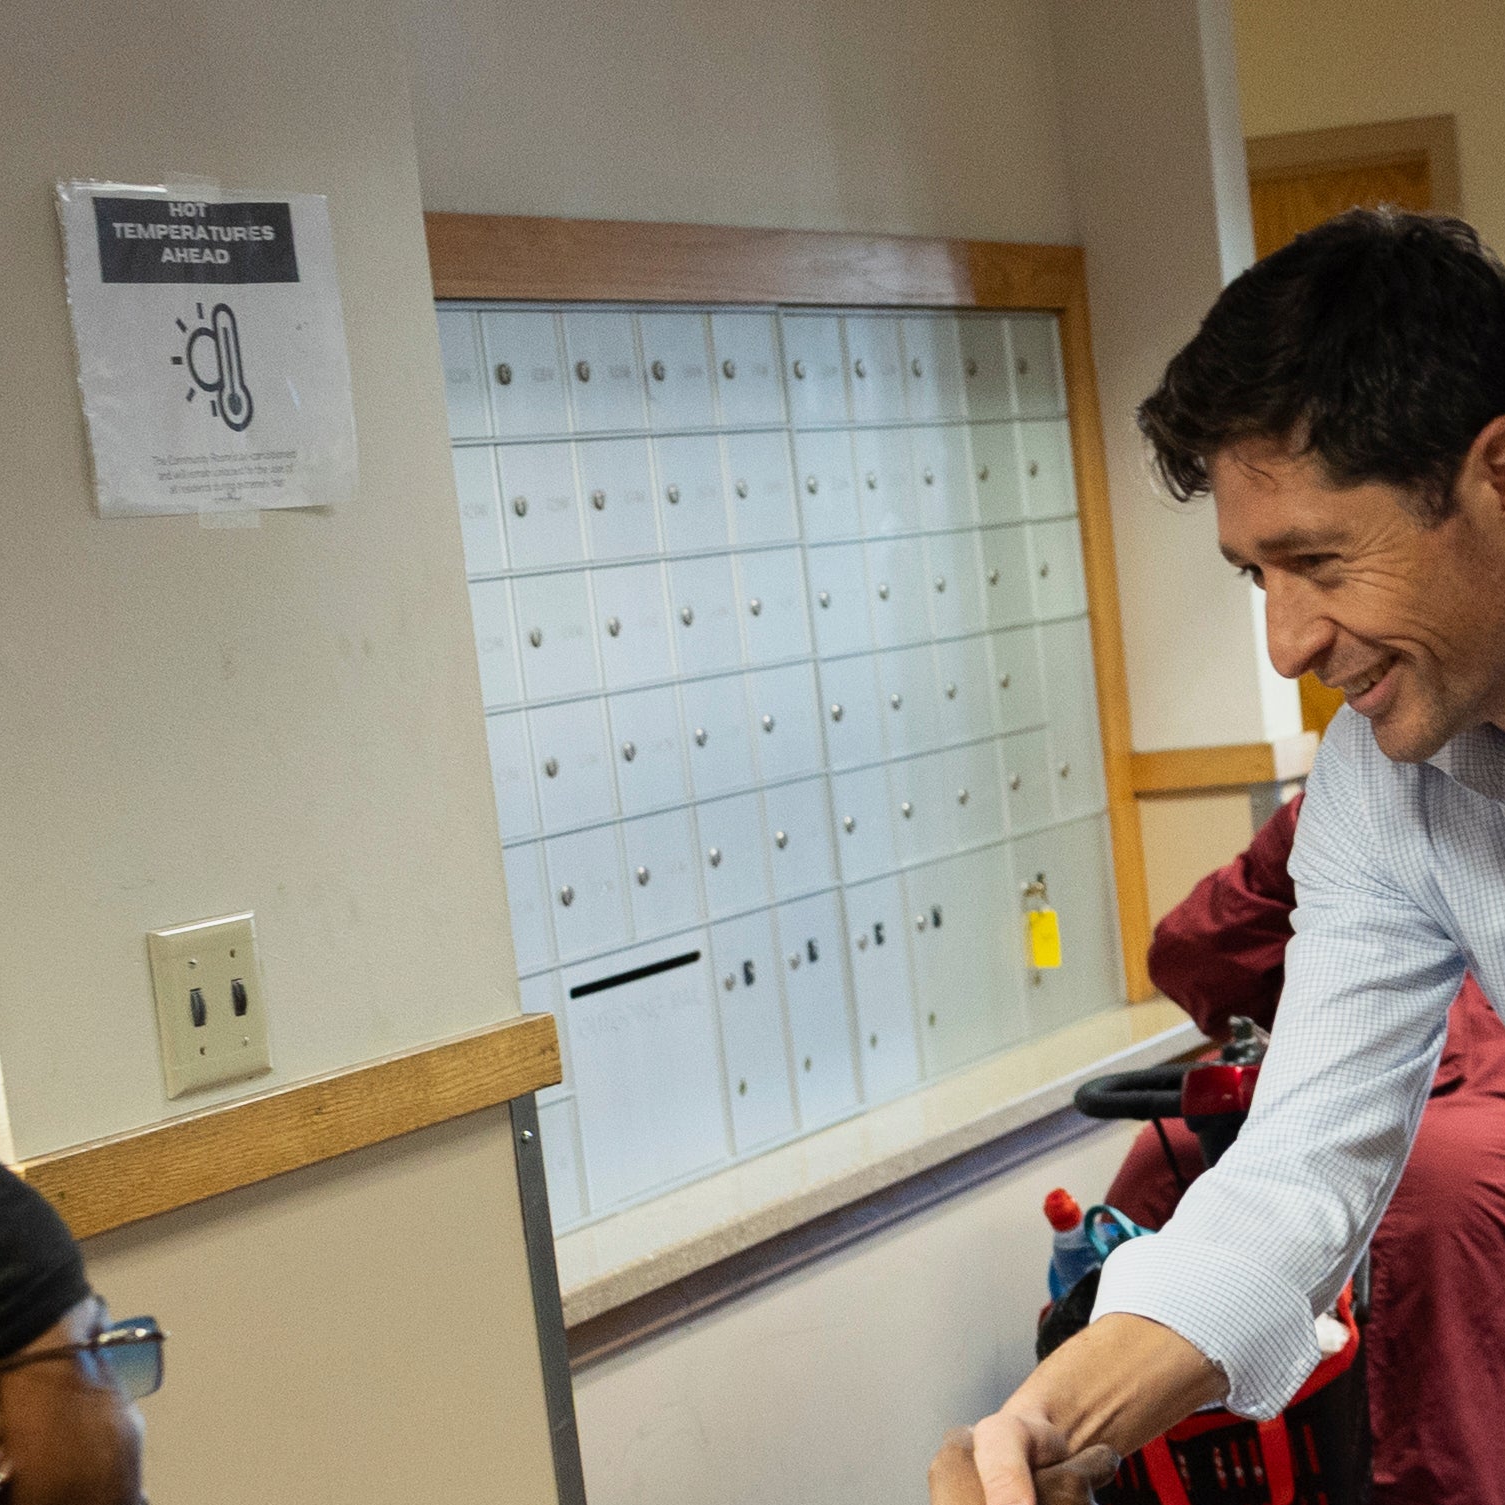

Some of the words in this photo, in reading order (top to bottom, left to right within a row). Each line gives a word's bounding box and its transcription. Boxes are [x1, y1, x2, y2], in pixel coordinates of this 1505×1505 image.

[168, 202, 207, 217] HOT
[112, 222, 276, 242] TEMPERATURES
[160, 247, 230, 264] AHEAD
